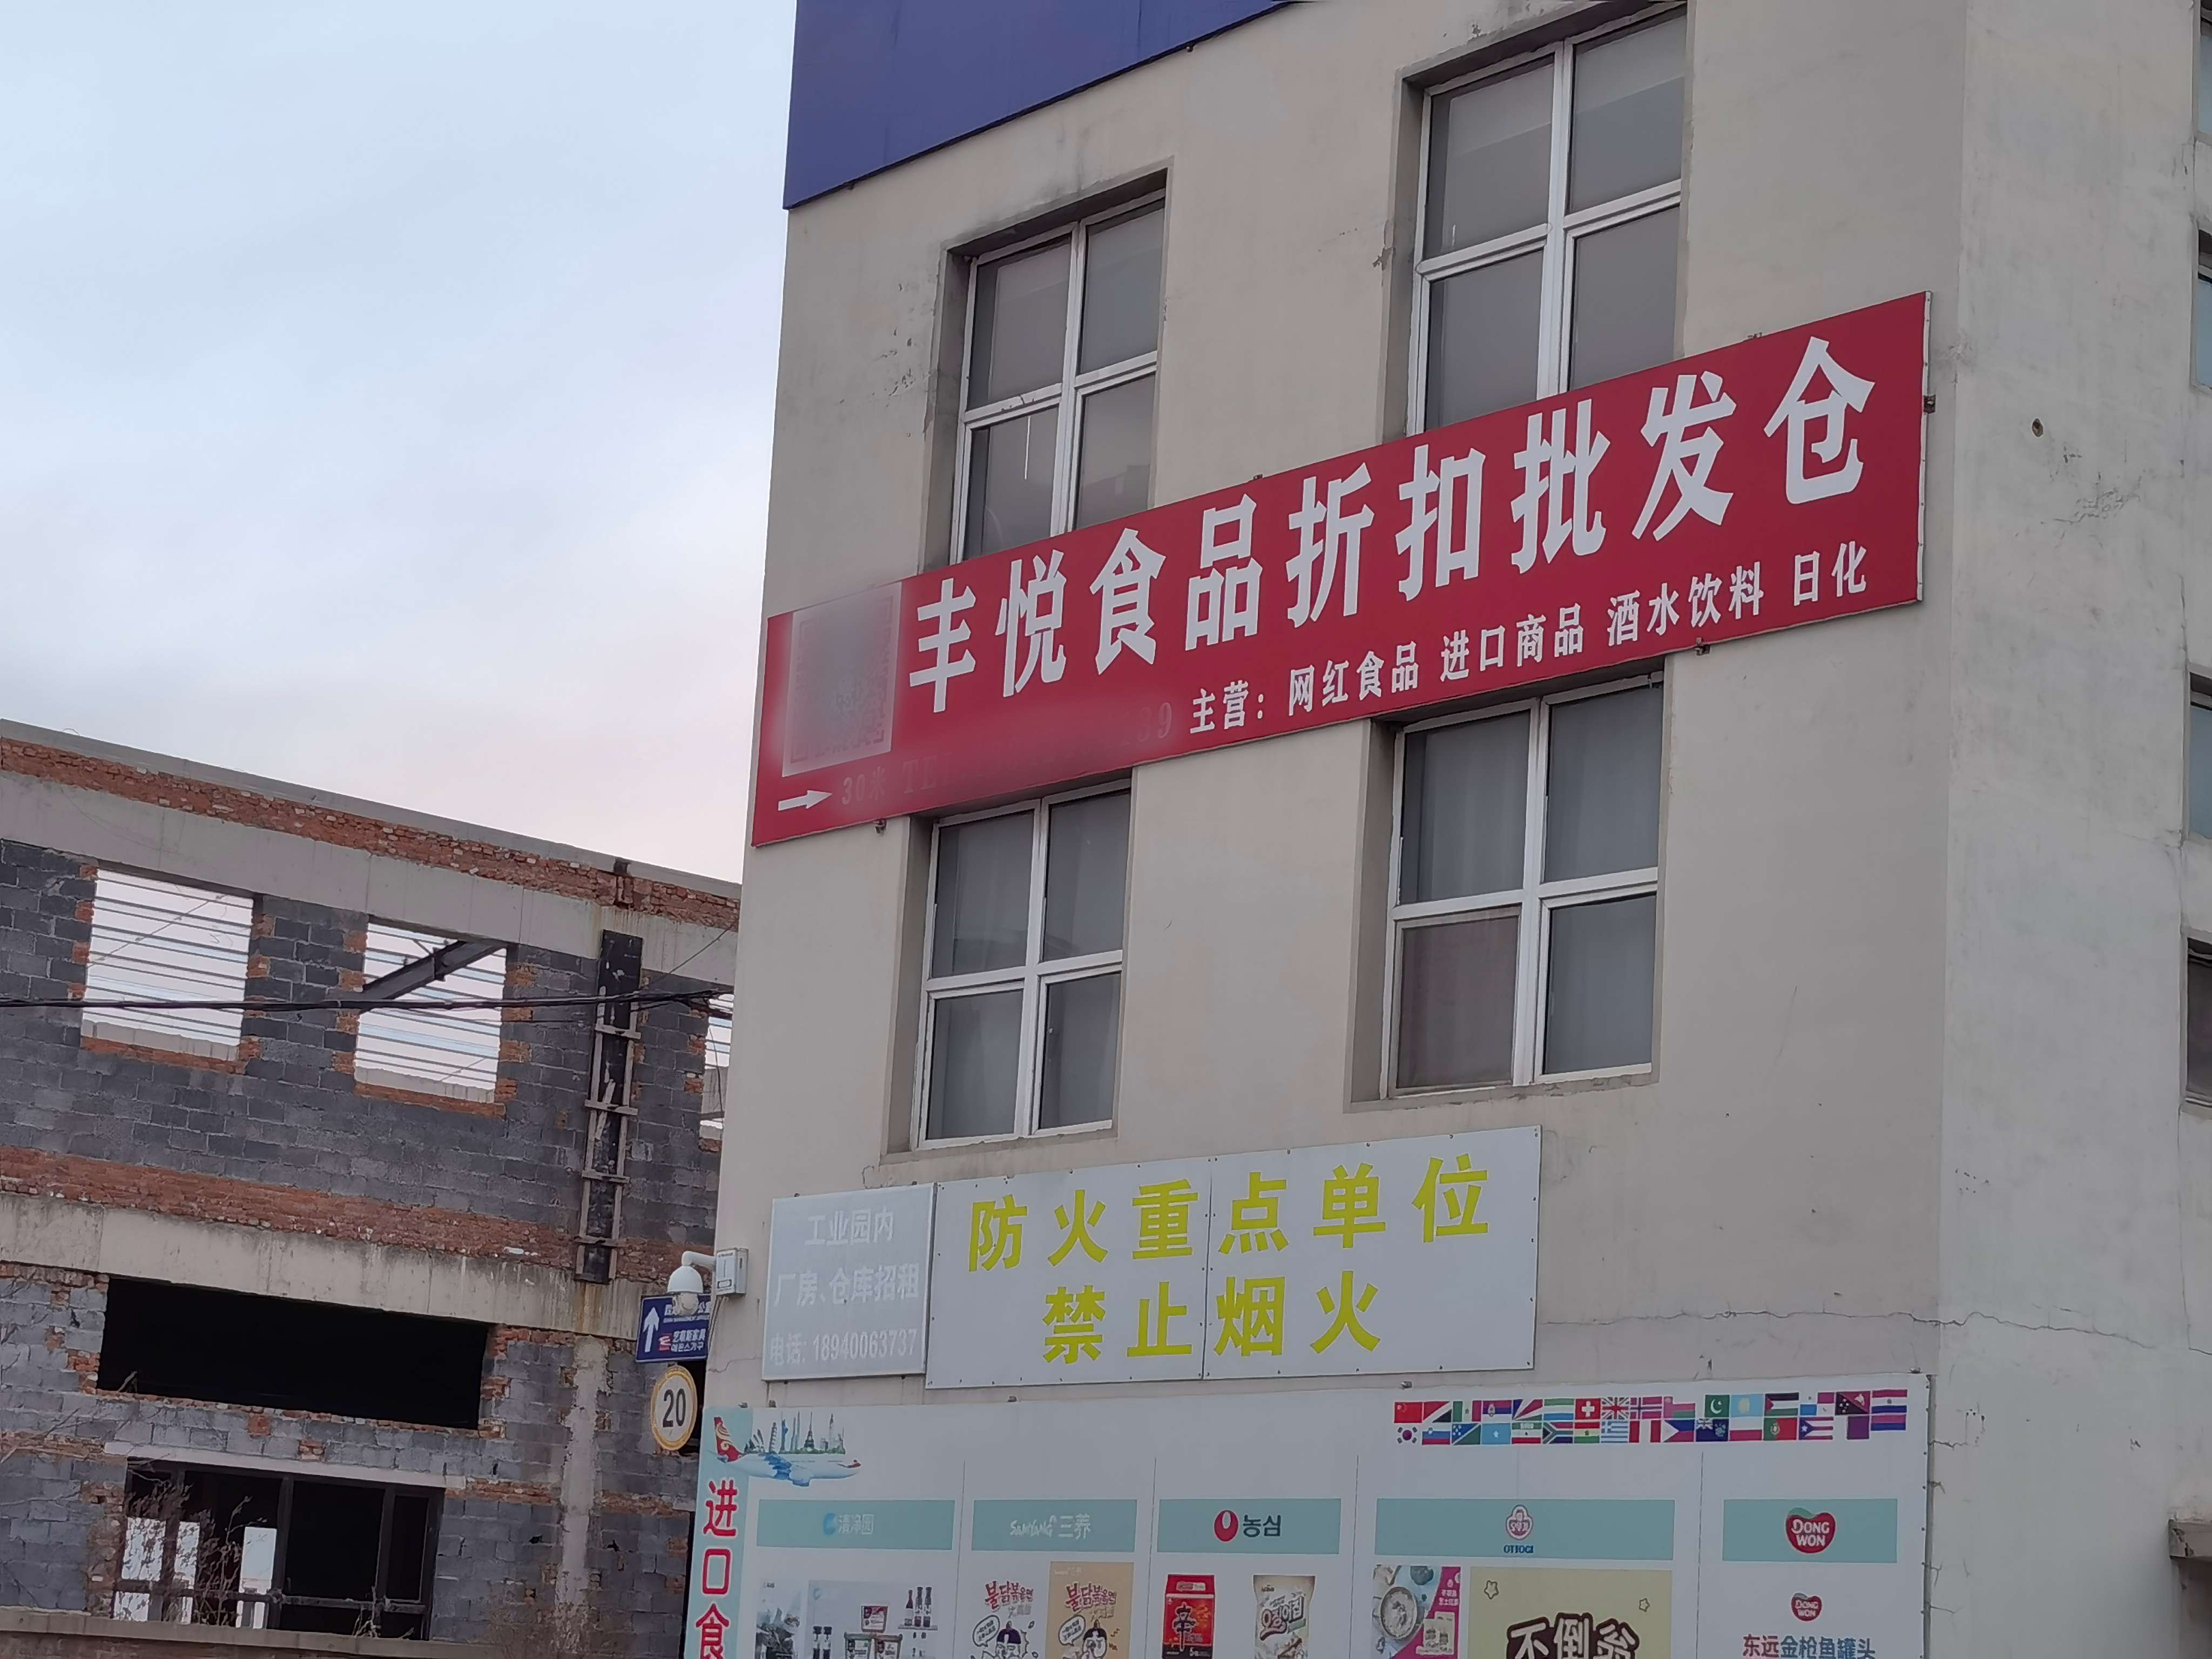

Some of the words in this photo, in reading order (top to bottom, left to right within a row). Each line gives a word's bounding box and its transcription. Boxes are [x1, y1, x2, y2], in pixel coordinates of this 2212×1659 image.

[909, 336, 1876, 713] 丰悦食品折扣批发仓
[1190, 679, 1265, 735] 主营：
[1288, 640, 1419, 716] 网红食品
[1440, 602, 1585, 683] 进口商品
[1607, 561, 1764, 647] 酒水饮料
[1792, 542, 1868, 607] 日化
[805, 1206, 894, 1246] 工业园内
[969, 1153, 1489, 1273] 防火重点单位
[774, 1263, 920, 1307] 厂房、仓库招租
[1042, 1270, 1381, 1364] 禁止烟火
[813, 1328, 918, 1361] 18940063737
[662, 1388, 686, 1428] 20
[1058, 1513, 1091, 1540] 三养
[1242, 1514, 1282, 1538] 농심
[1791, 1519, 1830, 1534] DONG
[1796, 1534, 1826, 1547] WON
[1503, 1545, 1534, 1554] OTTOGI
[1795, 1599, 1819, 1609] DONG
[1797, 1608, 1816, 1617] WON
[1742, 1633, 1876, 1658] 东远金枪鱼罐头
